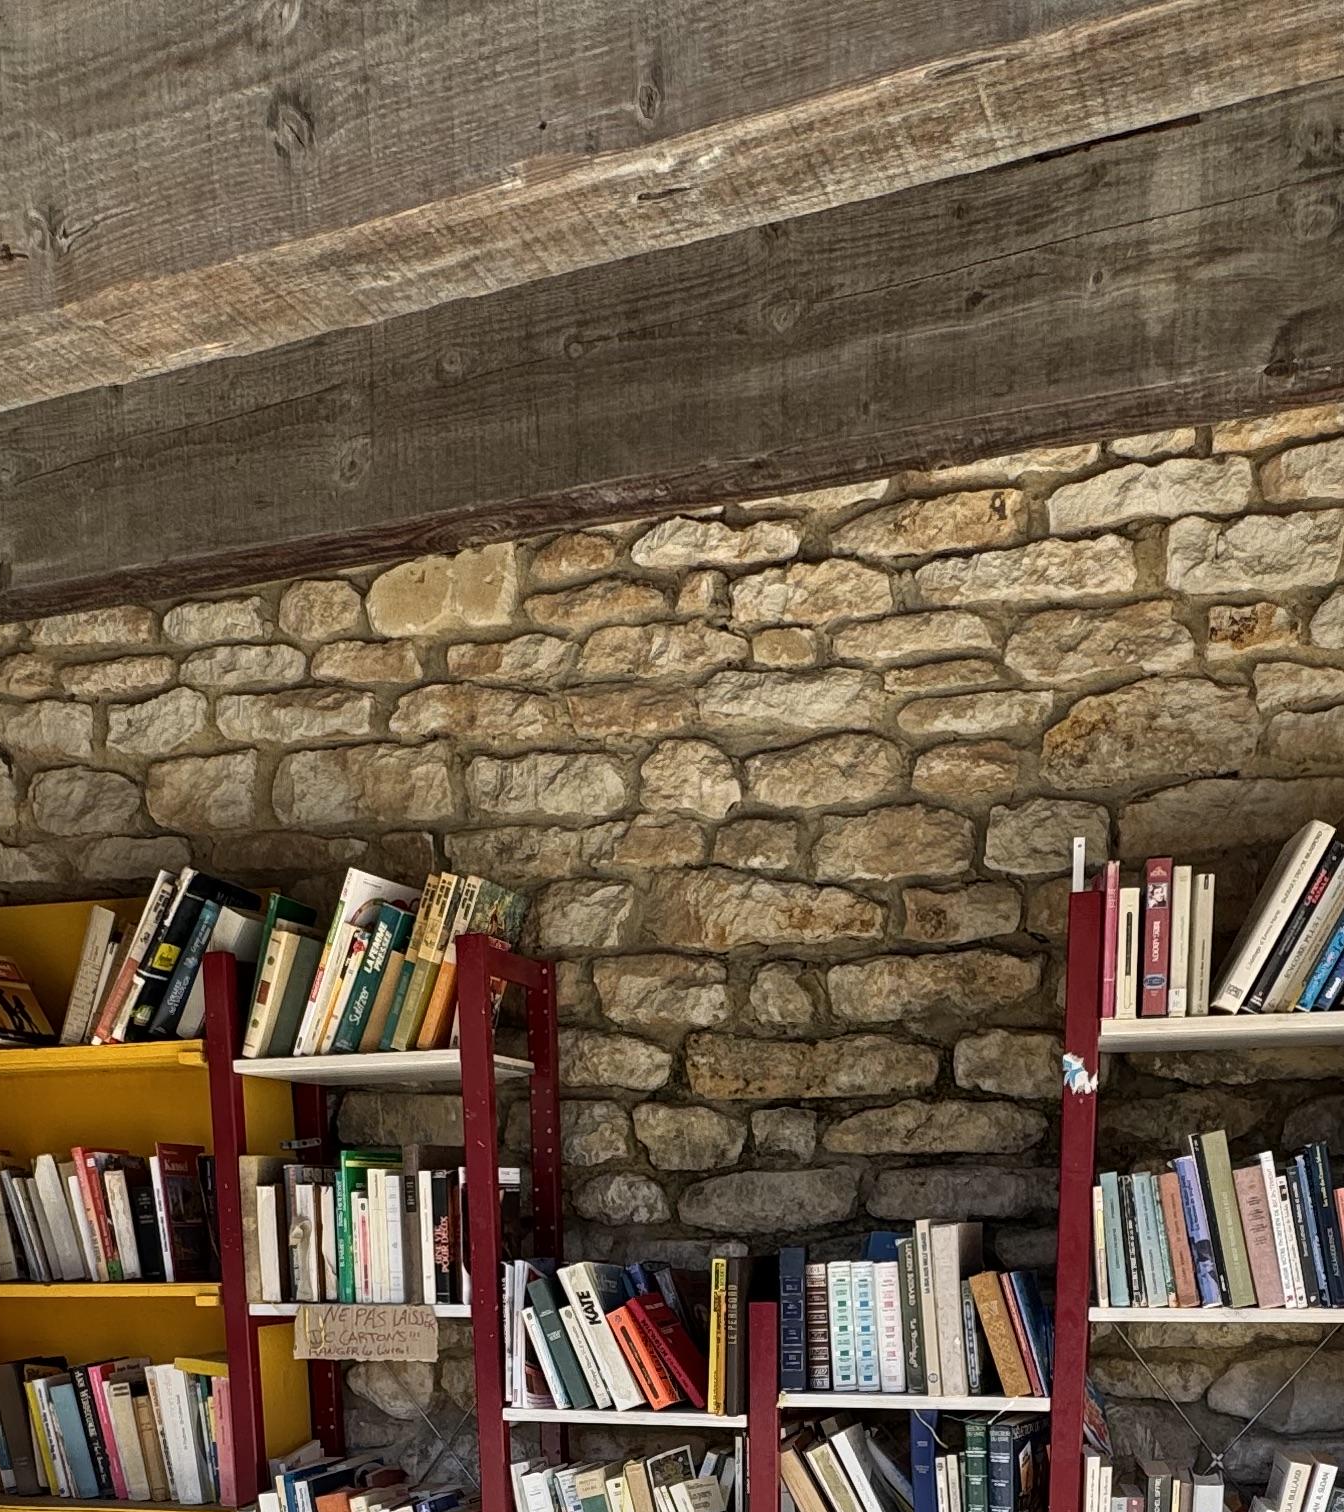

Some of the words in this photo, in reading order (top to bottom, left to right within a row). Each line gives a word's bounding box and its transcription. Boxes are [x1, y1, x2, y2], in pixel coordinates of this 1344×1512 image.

[368, 920, 388, 959] FEMME
[363, 959, 375, 973] LA
[347, 984, 370, 1025] Sulitzer
[324, 1305, 350, 1323] NE
[355, 1308, 386, 1328] PAS
[575, 1287, 602, 1327] KATE
[339, 1330, 406, 1345] CARTONS
[309, 1346, 359, 1356] RANGER
